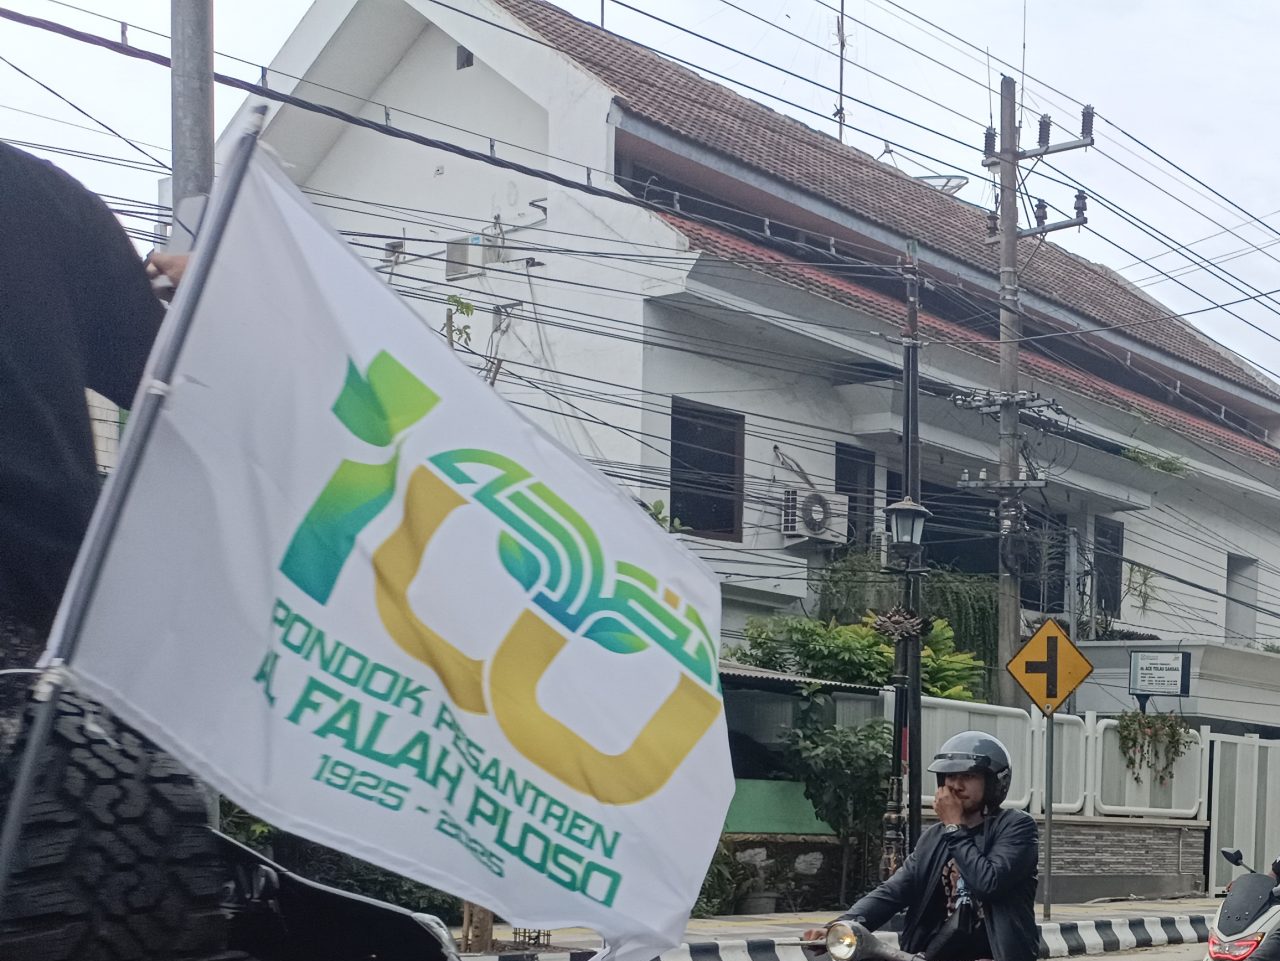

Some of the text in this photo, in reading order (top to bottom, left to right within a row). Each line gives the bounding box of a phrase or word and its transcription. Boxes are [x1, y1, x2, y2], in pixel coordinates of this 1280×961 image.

[271, 597, 621, 859] PONDOK PESANTREN
[283, 675, 465, 804] FALAH
[465, 786, 622, 908] PLOSO
[312, 753, 411, 811] 1925
[434, 809, 505, 878] 2025
